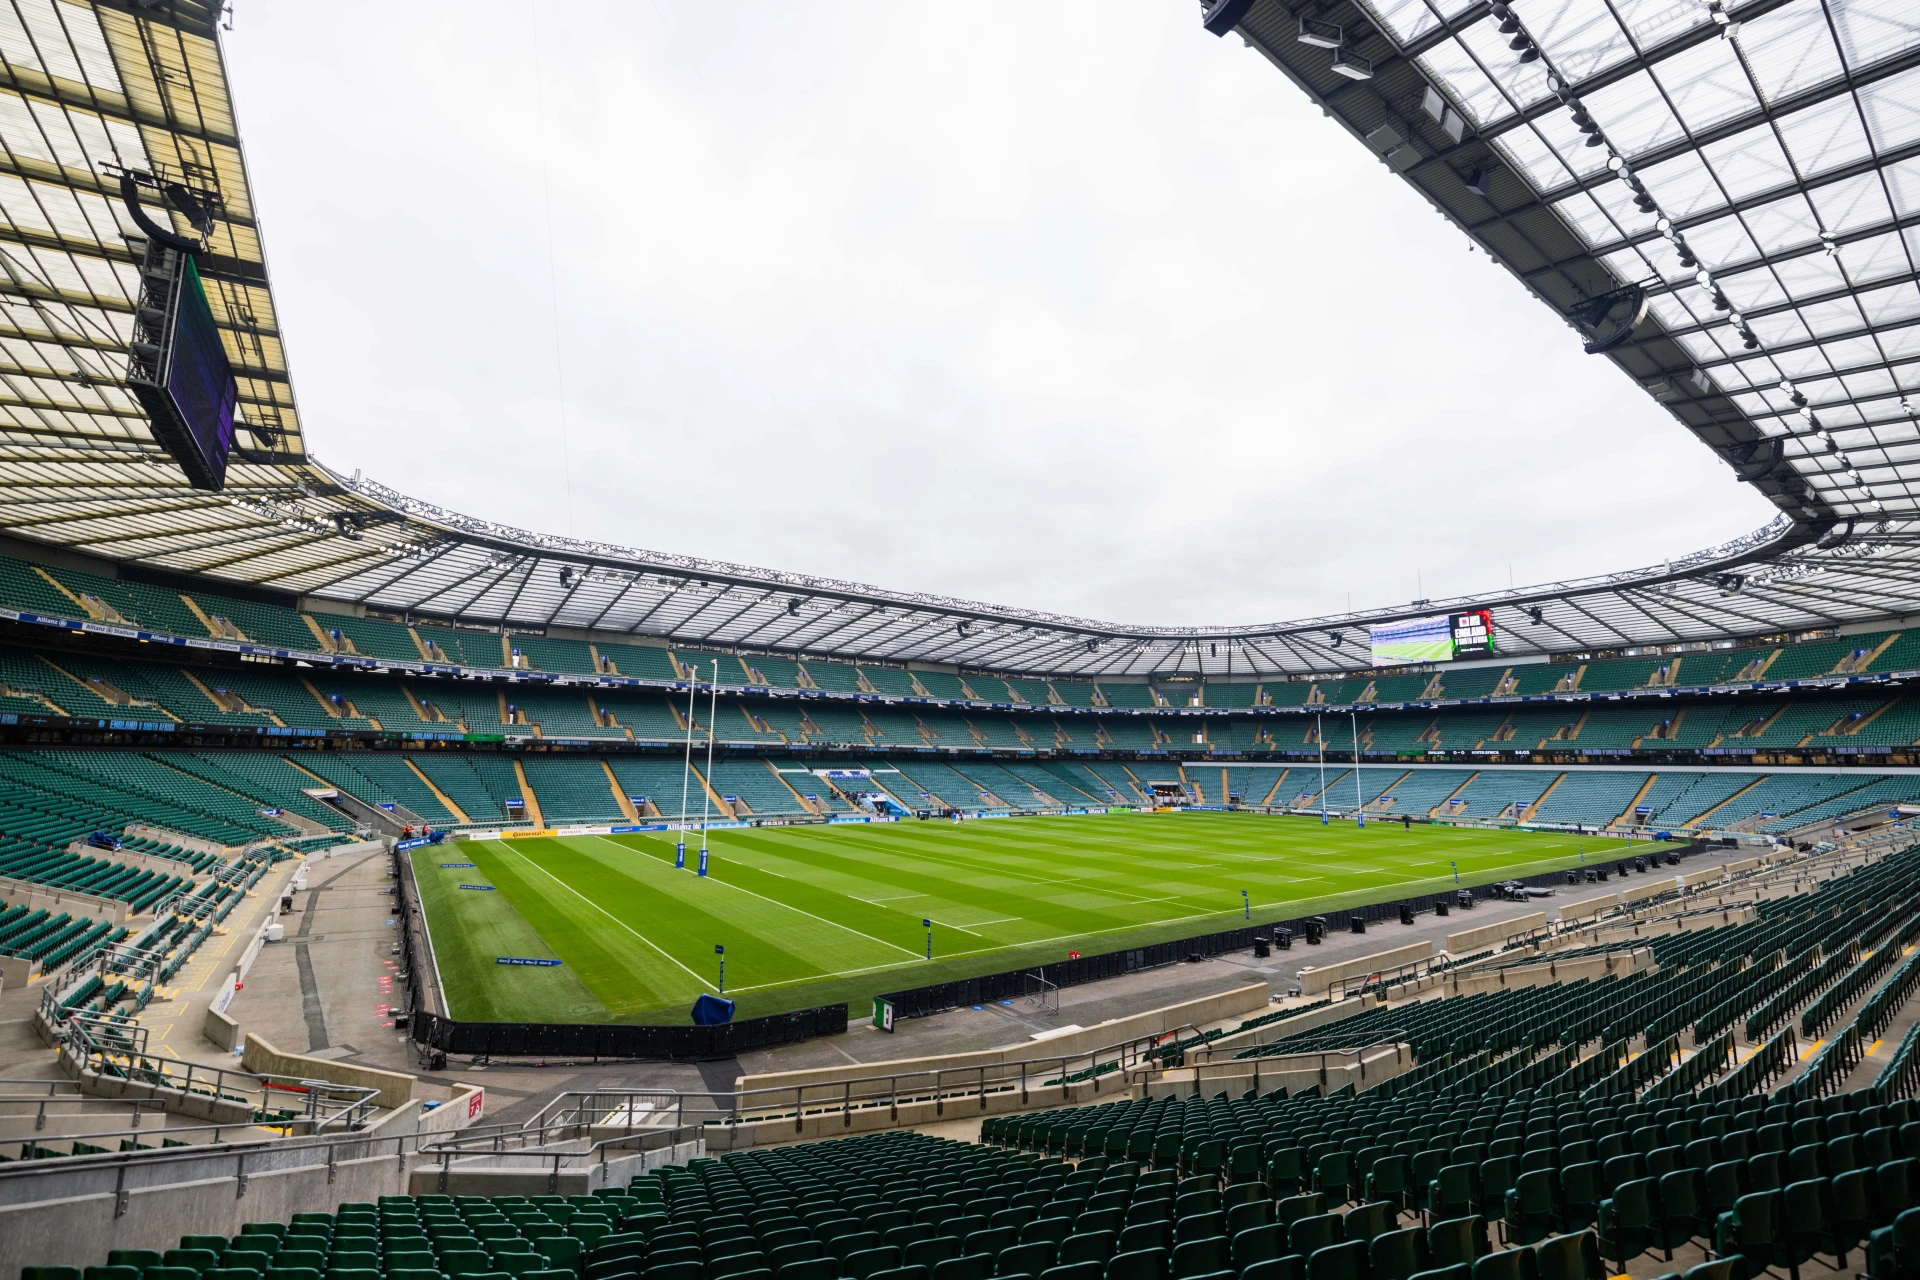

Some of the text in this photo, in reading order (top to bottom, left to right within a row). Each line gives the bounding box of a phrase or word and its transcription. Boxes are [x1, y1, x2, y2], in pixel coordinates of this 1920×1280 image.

[36, 616, 58, 625] Allianz
[86, 624, 135, 637] Allianz Stadium
[1, 714, 18, 724] AFRICA
[110, 720, 138, 730] ENGLAND
[143, 722, 158, 731] SOUTH
[159, 723, 175, 732] AFRICA
